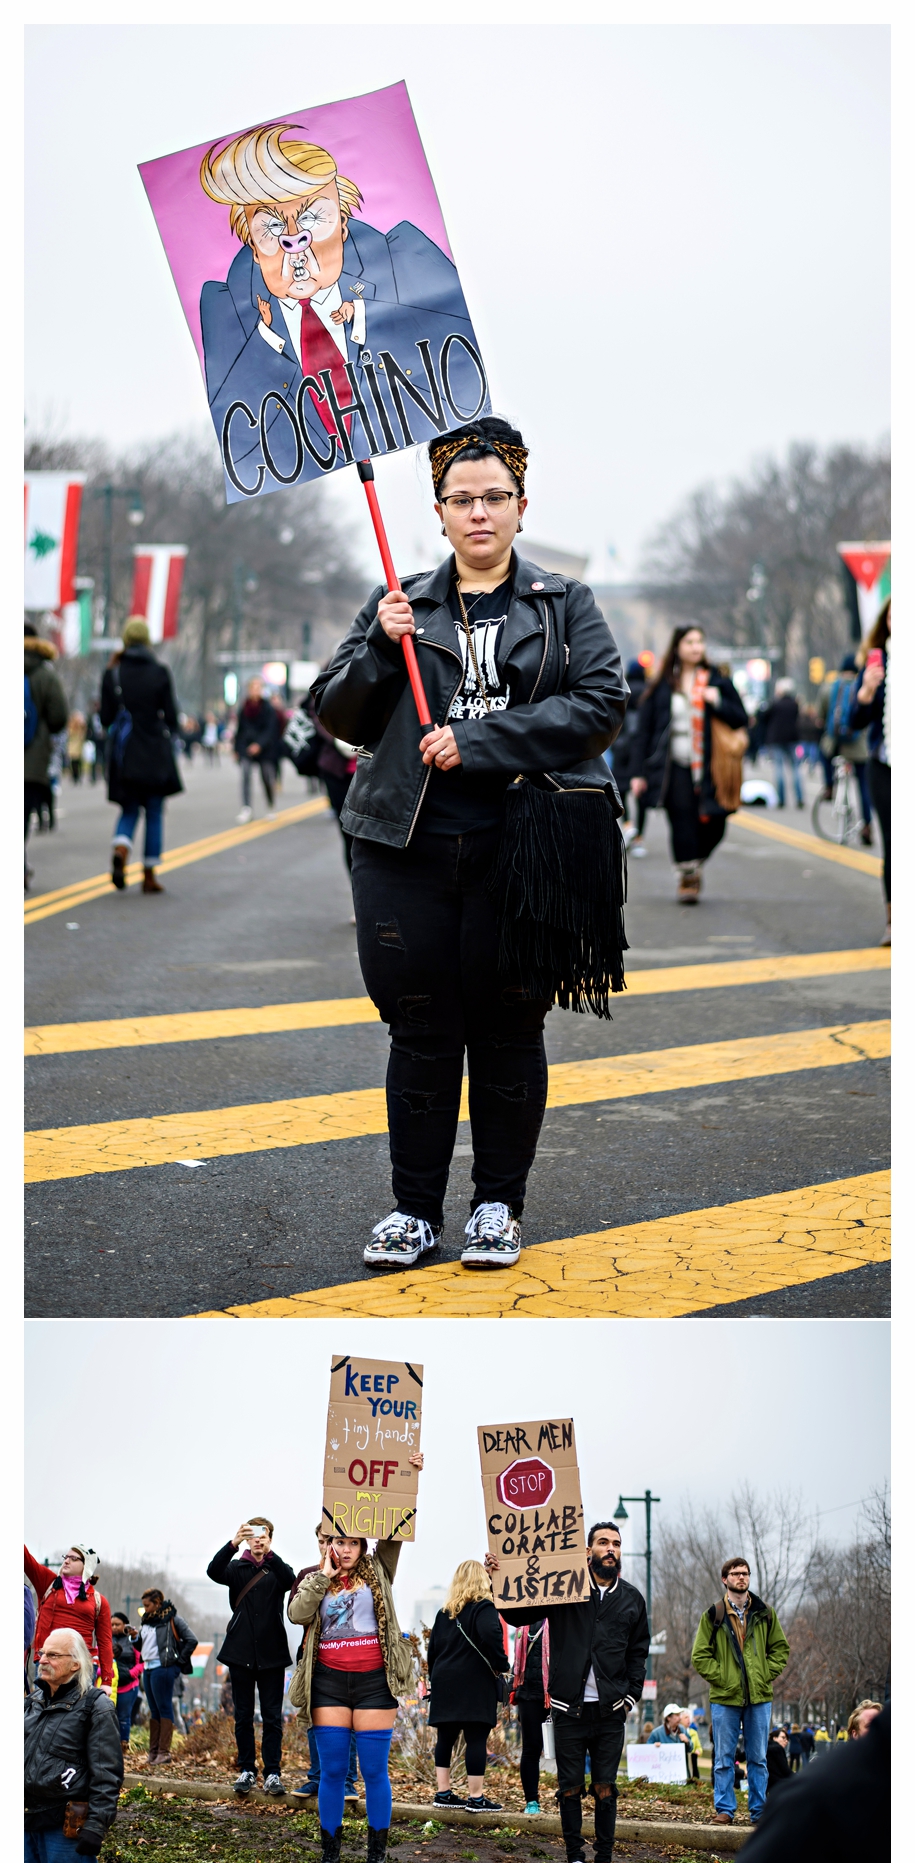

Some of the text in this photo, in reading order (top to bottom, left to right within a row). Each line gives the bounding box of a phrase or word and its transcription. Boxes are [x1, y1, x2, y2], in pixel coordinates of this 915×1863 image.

[344, 1364, 399, 1397] KEEP
[367, 1397, 417, 1420] YOUR
[343, 1418, 370, 1450] tiny
[483, 1422, 573, 1455] DEAR MEN
[348, 1458, 399, 1487] OFF
[509, 1473, 546, 1495] STOP
[332, 1502, 415, 1538] RIGHTS
[502, 1529, 579, 1556] ORATE
[527, 1555, 540, 1576] &
[500, 1568, 585, 1602] LISTEN
